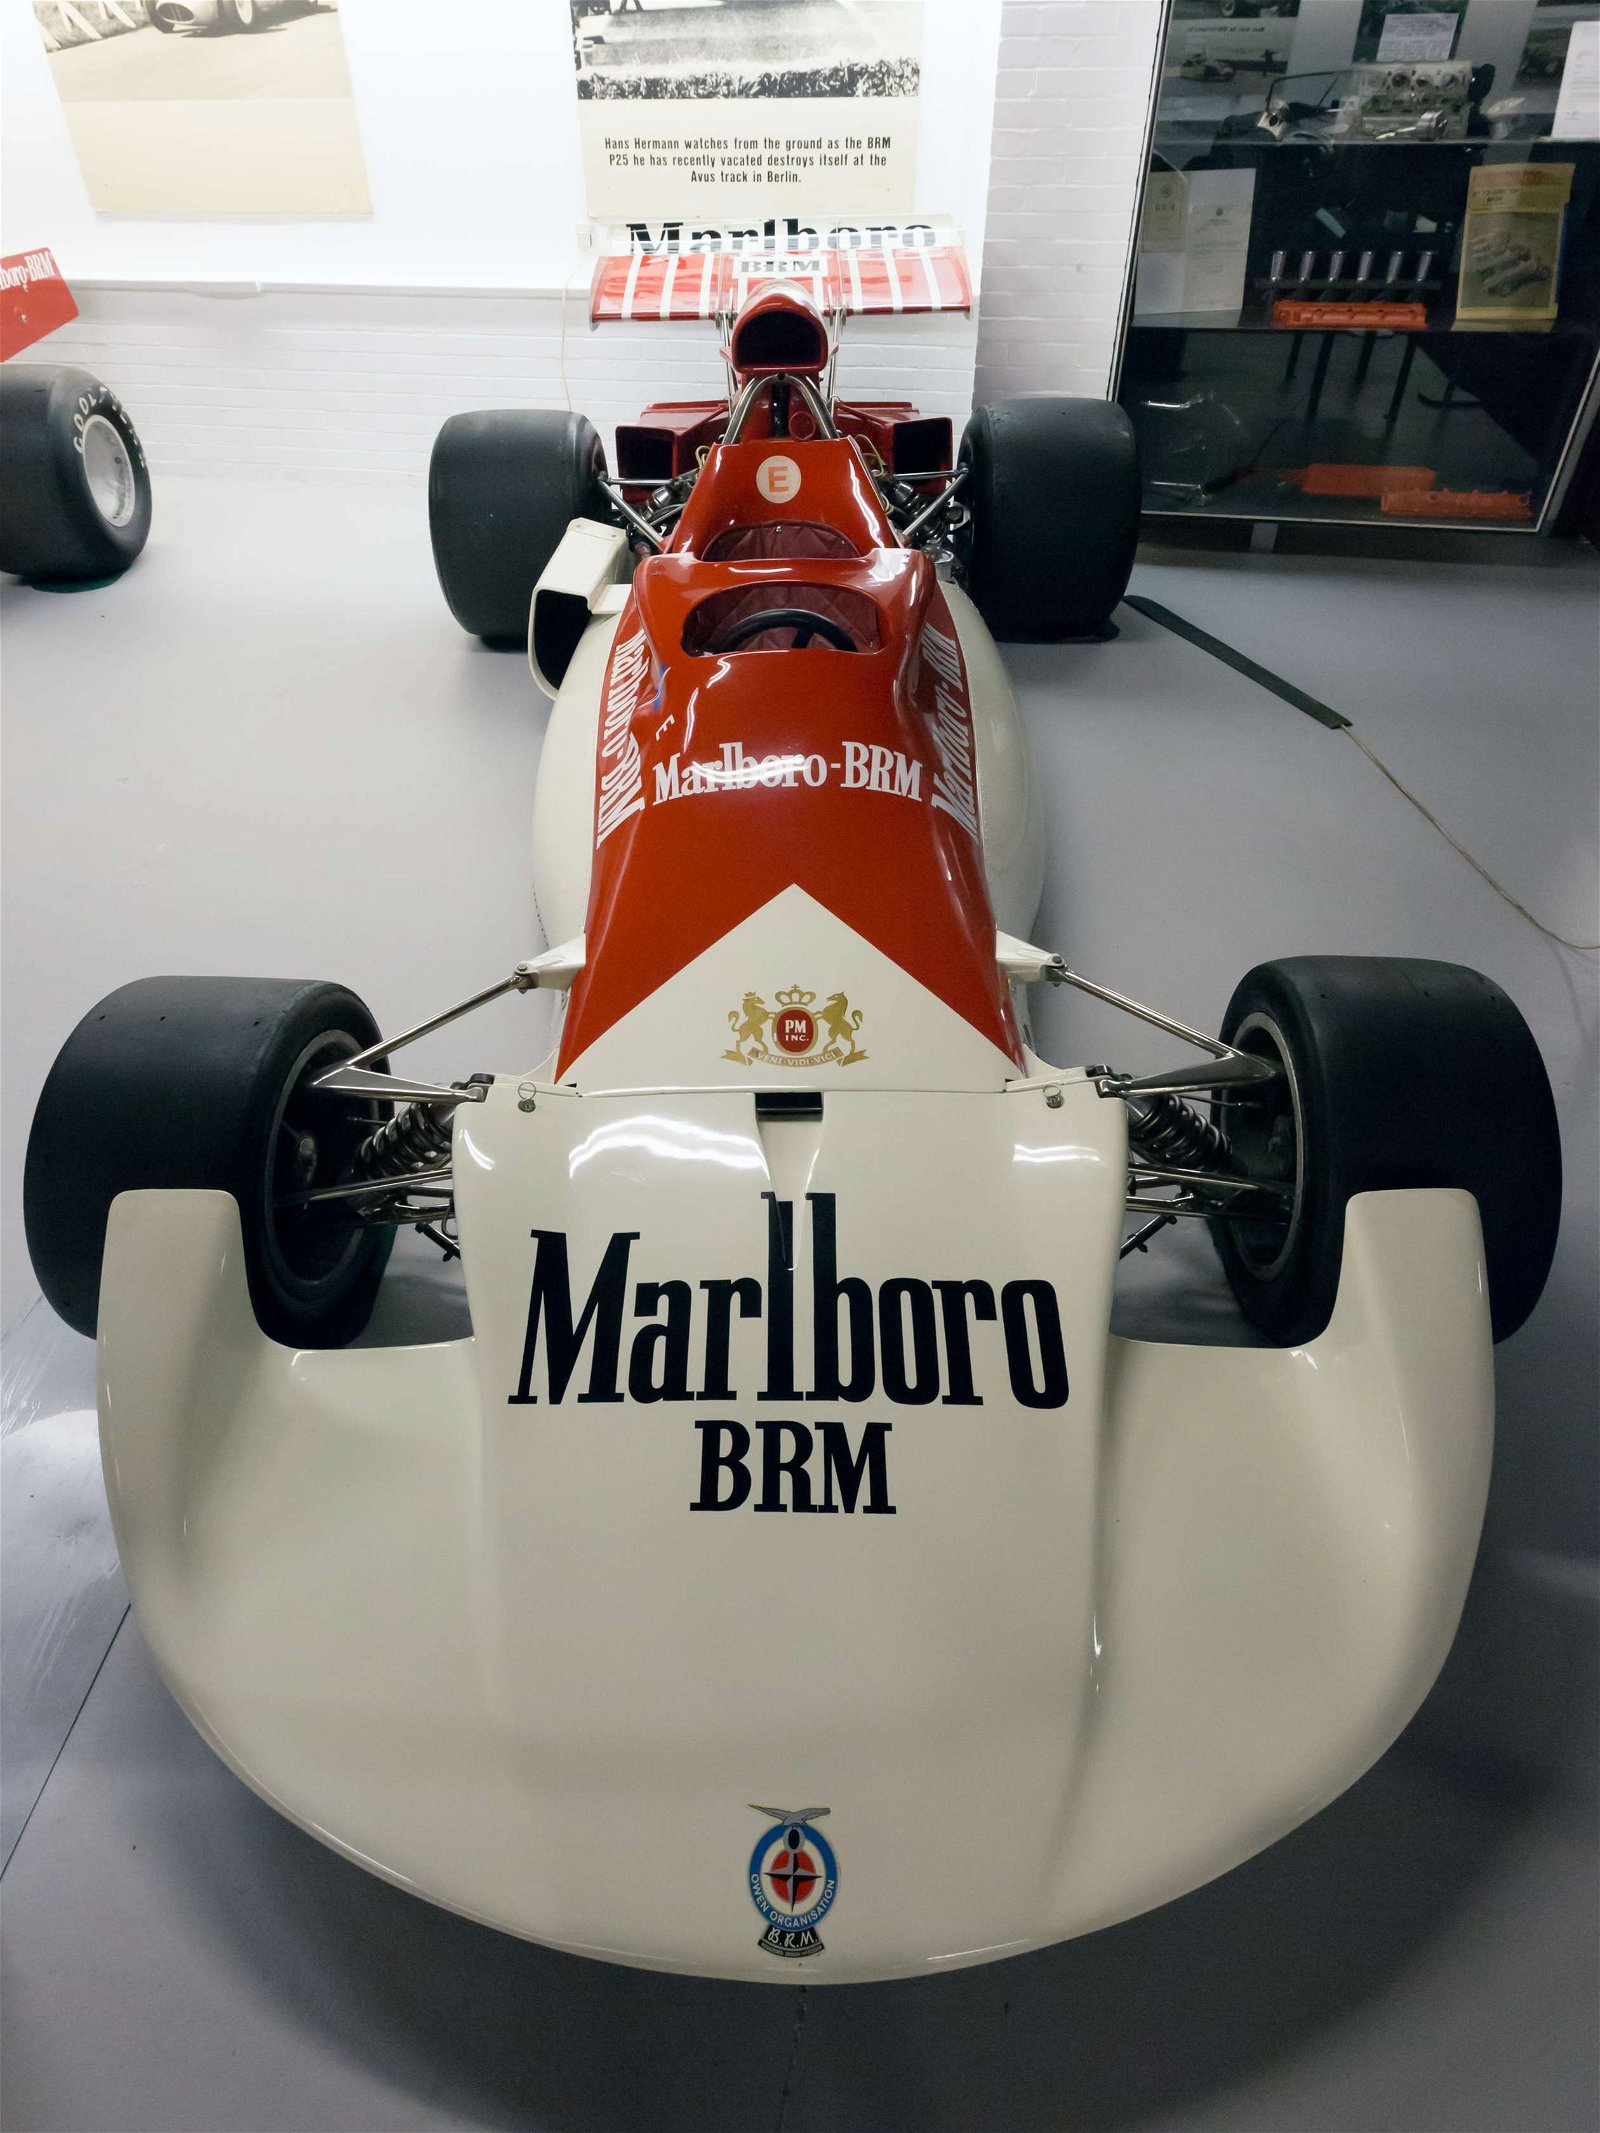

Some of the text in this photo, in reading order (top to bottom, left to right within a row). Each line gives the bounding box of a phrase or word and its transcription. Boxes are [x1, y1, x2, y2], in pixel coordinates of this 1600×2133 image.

[604, 136, 892, 152] Hans Hermann watches from the ground as the BRM
[609, 153, 887, 168] P25 he has recently vacated destroys itself at the
[690, 170, 802, 183] Avus track in Berlin.
[626, 217, 937, 255] Marlboro
[741, 260, 820, 273] BRM
[767, 465, 790, 493] E
[784, 1019, 807, 1034] PM
[784, 1034, 810, 1042] INC.
[507, 1191, 1070, 1410] Marlboro
[689, 1419, 897, 1515] BRM
[751, 1873, 835, 1928] OWEN ORGANISATION
